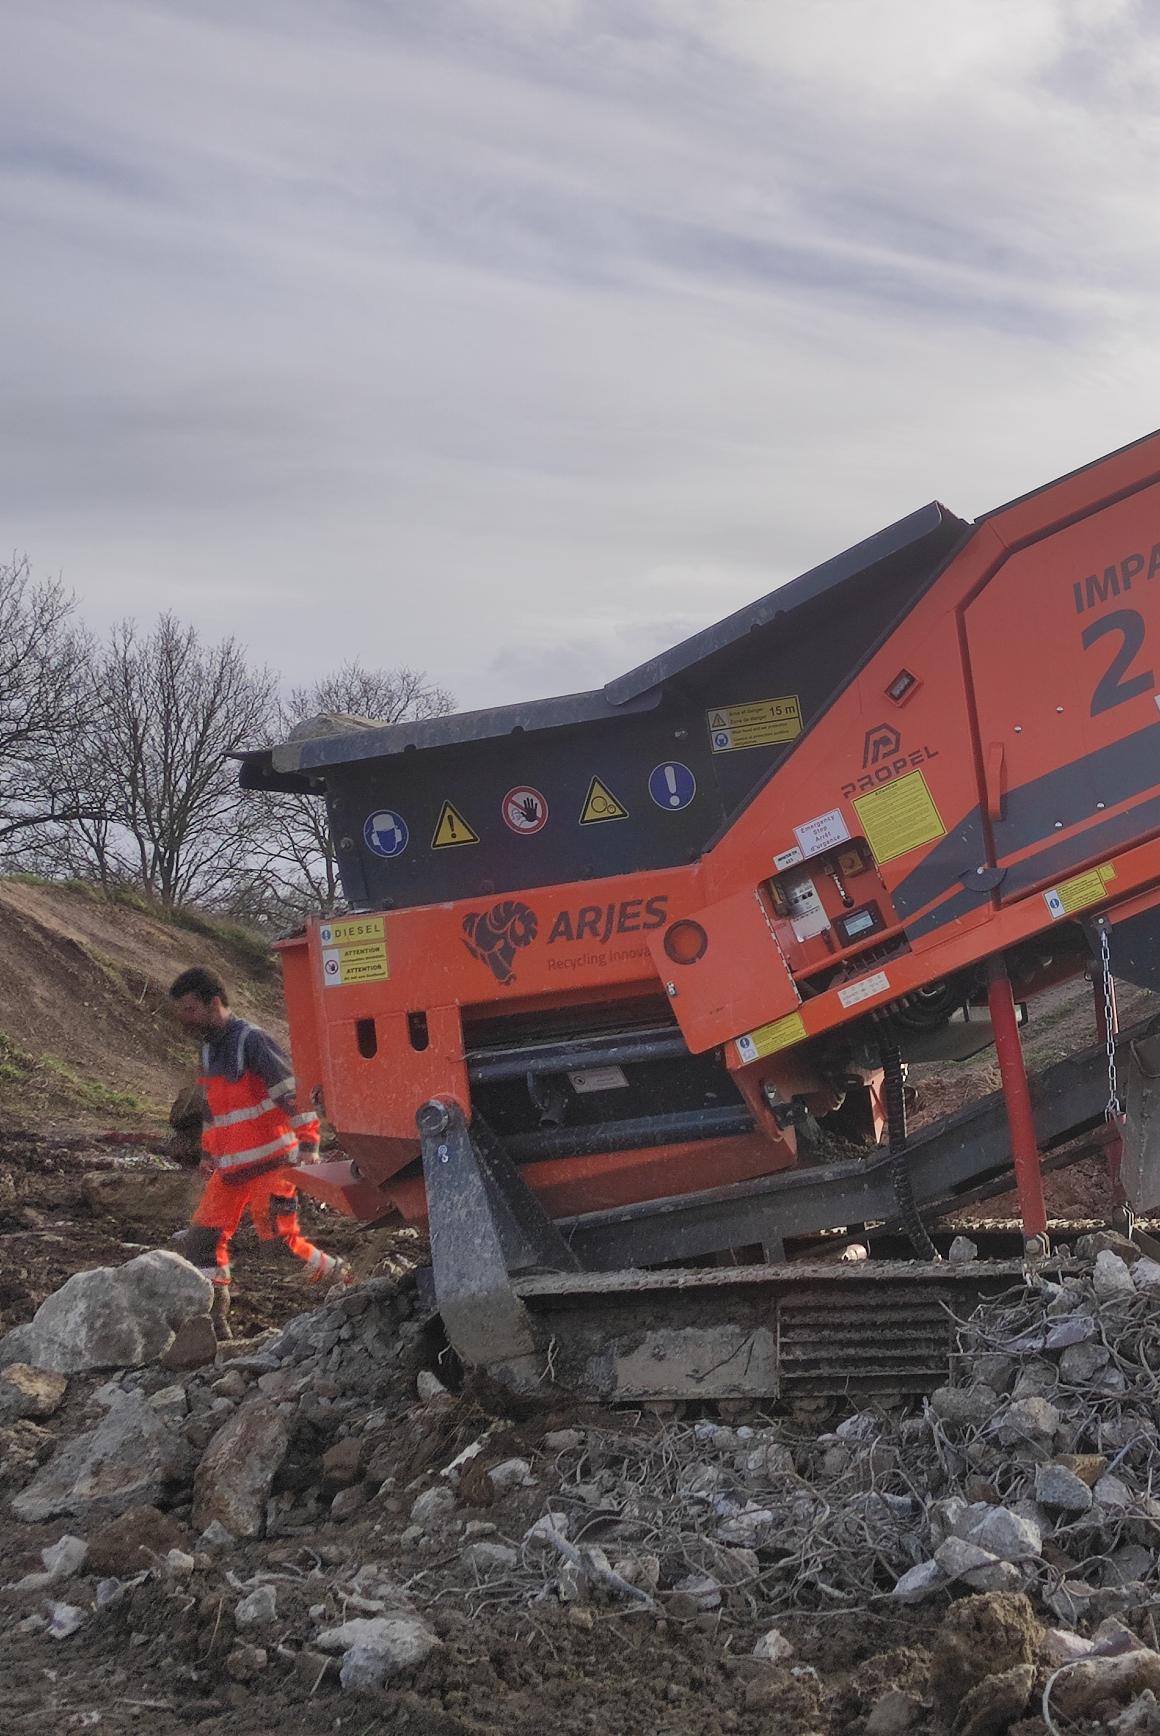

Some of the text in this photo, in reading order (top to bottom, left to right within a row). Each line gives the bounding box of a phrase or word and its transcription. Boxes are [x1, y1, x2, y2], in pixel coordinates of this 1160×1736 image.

[769, 705, 783, 717] 15
[784, 705, 796, 714] m
[840, 746, 939, 799] PROPEL
[800, 814, 835, 834] Emergency
[813, 826, 828, 835] Stop
[547, 895, 669, 945] ARJES
[335, 924, 381, 938] DIESEL
[344, 947, 380, 957] ATTENTION
[548, 946, 651, 971] Recycling Innova
[346, 964, 382, 974] ATTENTION
